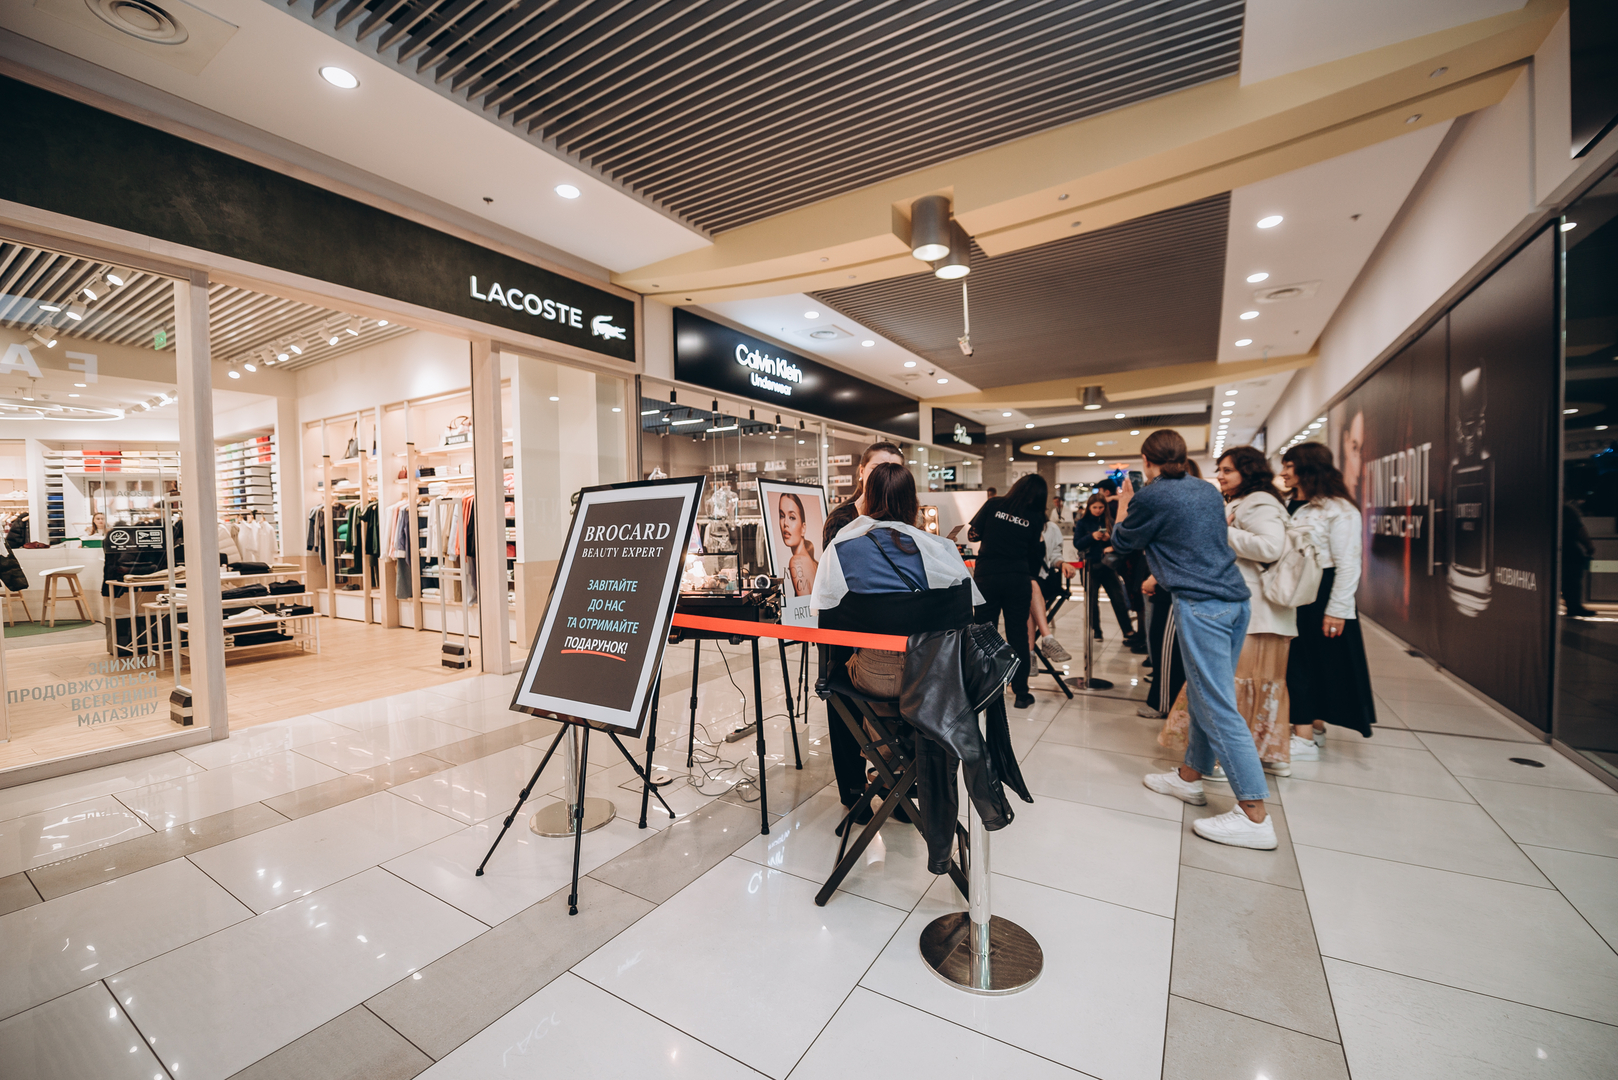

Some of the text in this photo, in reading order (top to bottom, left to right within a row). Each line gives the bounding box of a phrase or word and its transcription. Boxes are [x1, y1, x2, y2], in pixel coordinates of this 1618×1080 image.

[470, 275, 583, 329] LACOSTE
[735, 343, 803, 384] Calvin Klein
[750, 371, 792, 396] Underwear
[995, 510, 1030, 528] ARTDECO
[1370, 515, 1424, 539] GIVENCHY
[584, 522, 671, 542] BROCARD
[582, 546, 664, 558] BEAUTY EXPERT
[587, 578, 638, 593] ЗАВІТАЙТЕ
[1494, 566, 1538, 592] НОВИНКА
[587, 598, 626, 613] ДО НАС
[566, 616, 640, 634] ТА ОТРИМАЙТЕ
[564, 636, 628, 655] ПОДАРУНОК!
[88, 654, 156, 676] ЗНИЖКИ
[7, 670, 157, 705] ПРОДОВЖУЮТЬСЯ
[71, 686, 158, 711] ВСЕРЕДИНІ
[77, 701, 159, 727] МАГАЗИНУ
